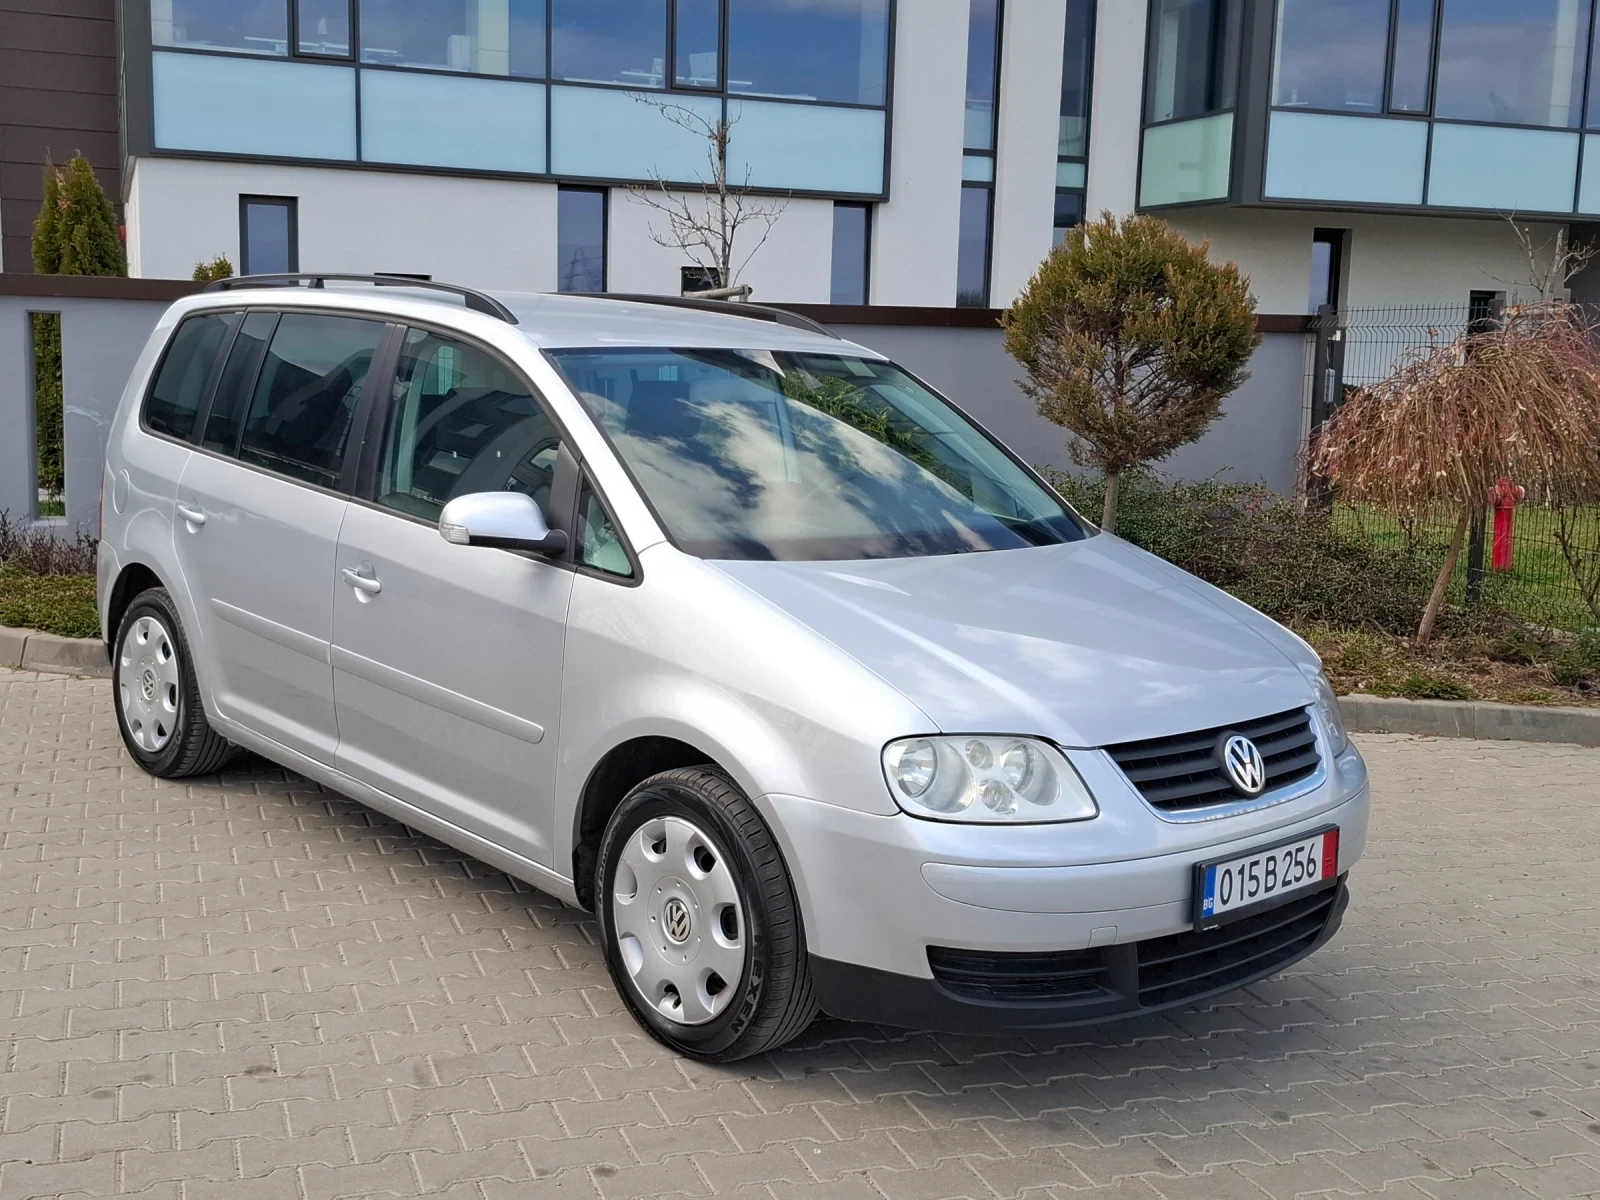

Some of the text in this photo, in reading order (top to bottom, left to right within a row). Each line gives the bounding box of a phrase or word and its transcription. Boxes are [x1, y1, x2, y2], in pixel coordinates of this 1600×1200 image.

[1224, 735, 1265, 793] VW
[1219, 842, 1317, 906] 015B256
[663, 900, 691, 942] VW
[1203, 897, 1214, 910] BG
[730, 934, 763, 1035] NEXEN
